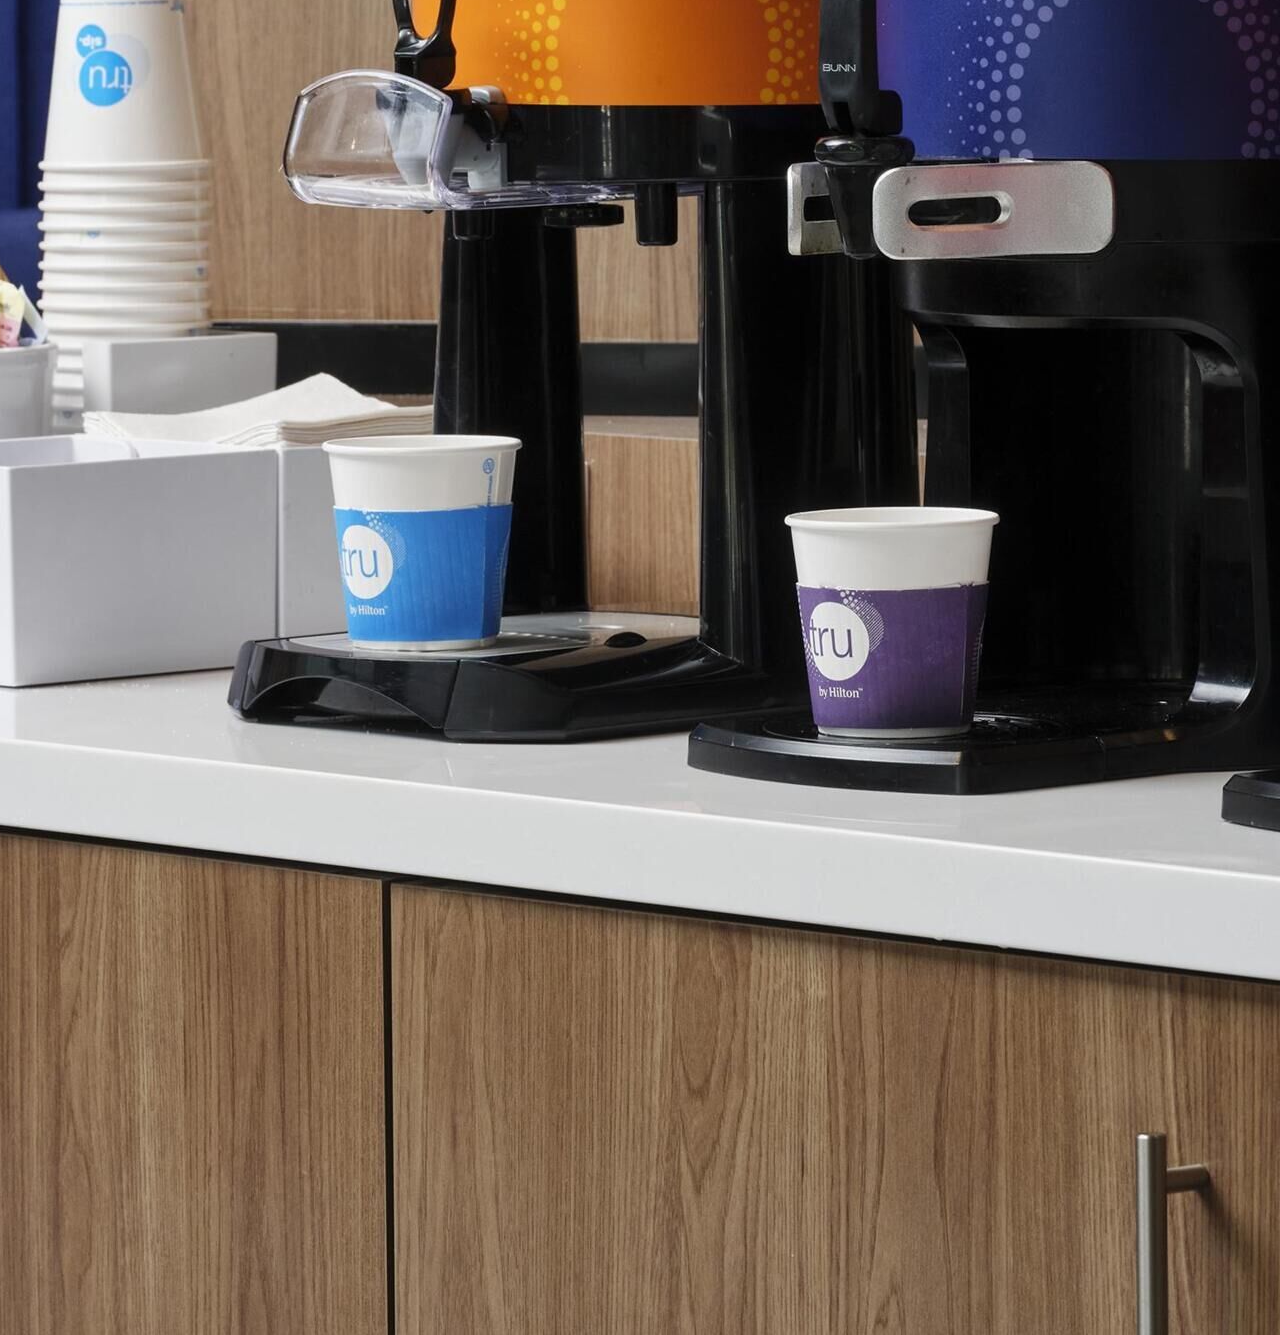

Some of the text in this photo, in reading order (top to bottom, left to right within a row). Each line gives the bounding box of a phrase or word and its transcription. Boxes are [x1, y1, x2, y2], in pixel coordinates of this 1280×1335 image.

[89, 65, 132, 94] tru
[822, 63, 857, 73] BUNN
[342, 541, 379, 578] tru
[808, 618, 853, 659] tru
[818, 685, 828, 699] by
